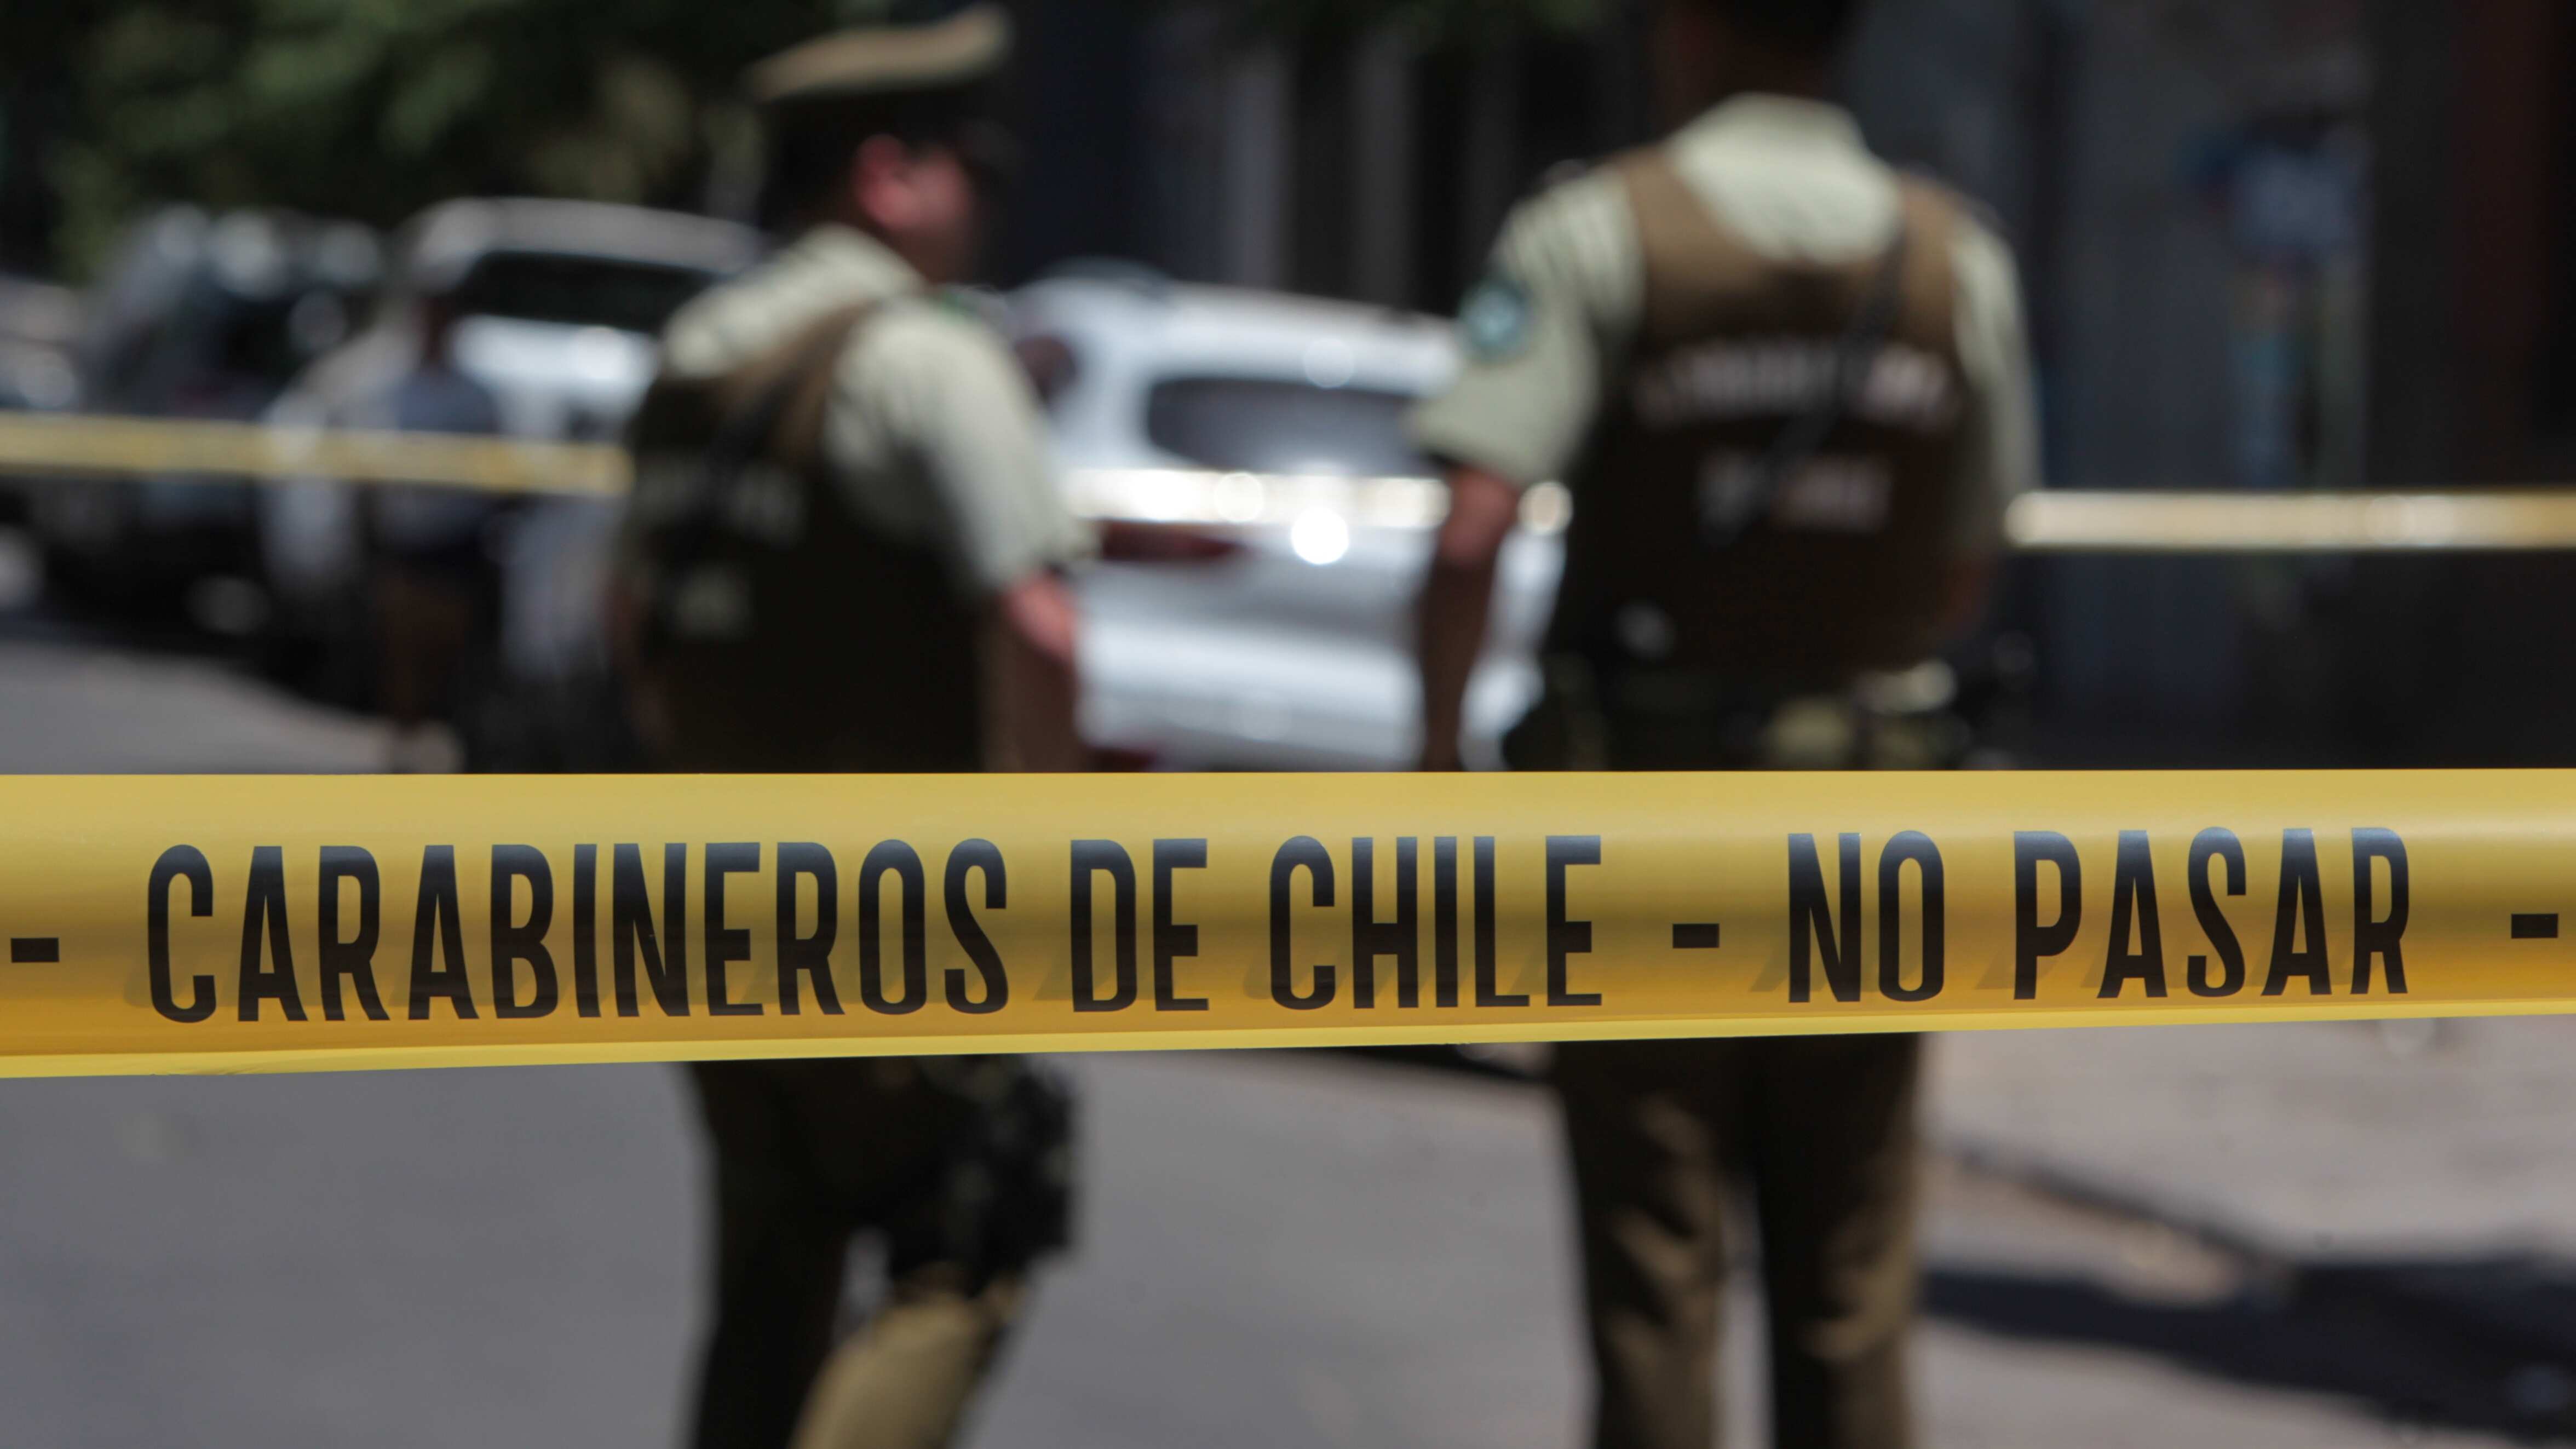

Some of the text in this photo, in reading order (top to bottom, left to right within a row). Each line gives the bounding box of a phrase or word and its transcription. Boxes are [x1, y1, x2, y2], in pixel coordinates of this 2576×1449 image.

[148, 839, 1008, 1022] CARABINEROS
[1070, 838, 1208, 1011] DE
[1269, 835, 1602, 1009] CHILE
[1787, 830, 1944, 1002] NO
[2013, 826, 2410, 999] PASAR
